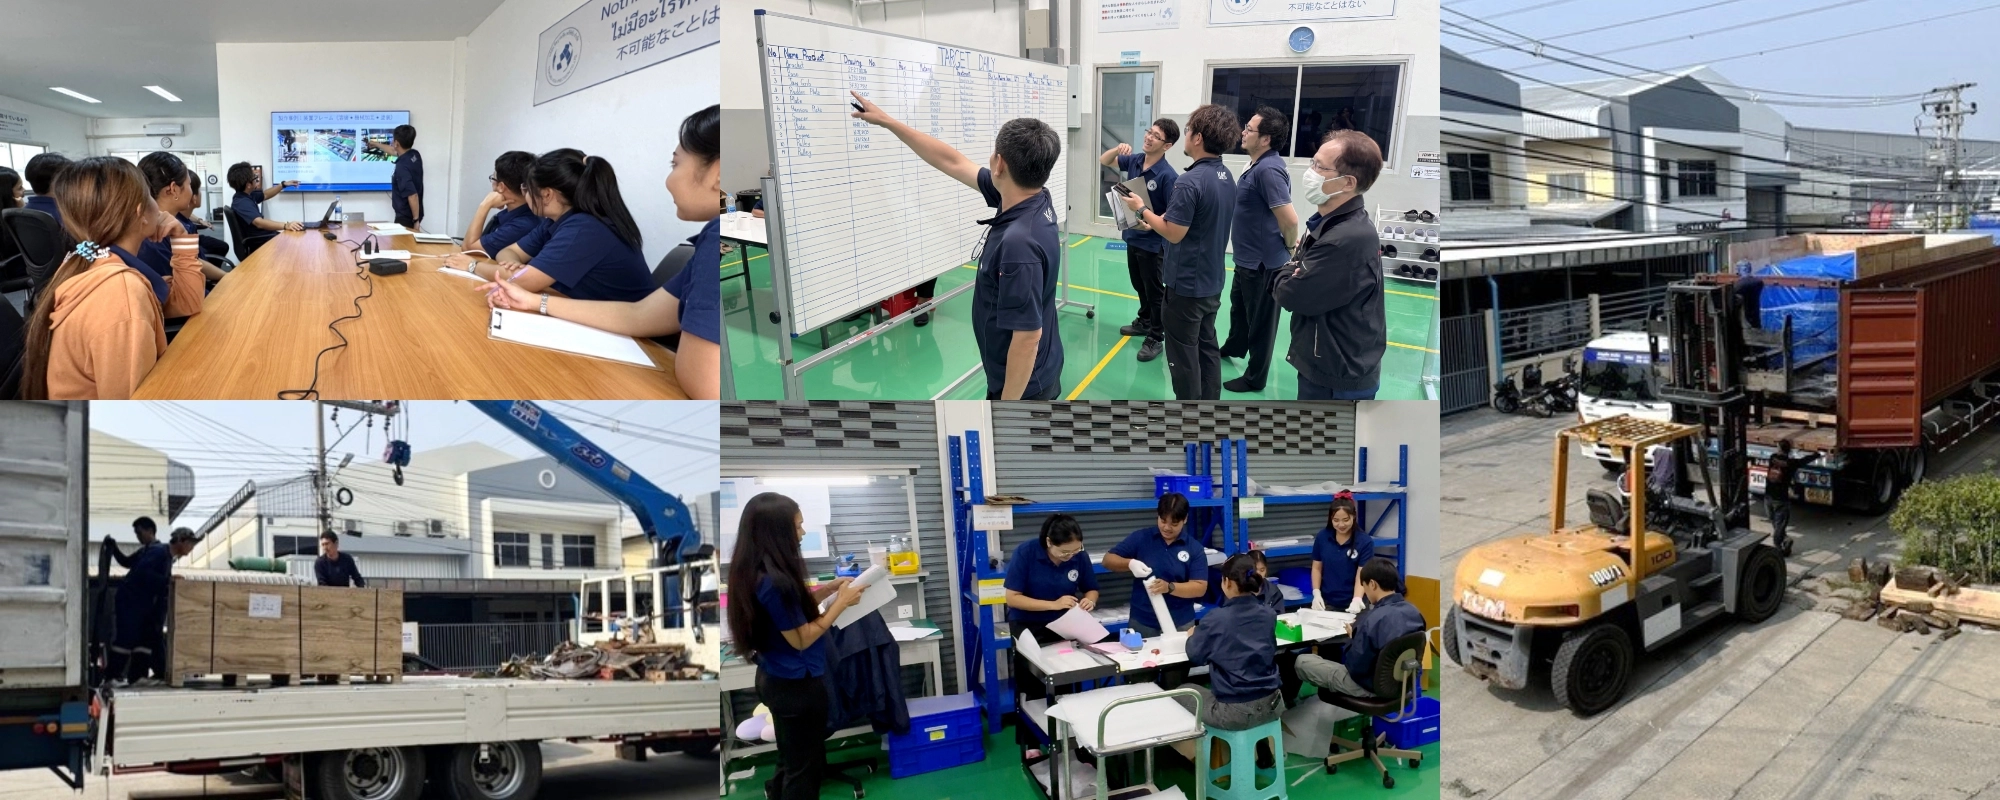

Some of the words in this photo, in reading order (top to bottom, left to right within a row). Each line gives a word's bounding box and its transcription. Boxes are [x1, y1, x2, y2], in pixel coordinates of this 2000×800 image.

[938, 46, 971, 70] TARGET
[1651, 550, 1673, 565] 100
[1589, 564, 1626, 587] 100/1
[1462, 589, 1506, 620] TCM
